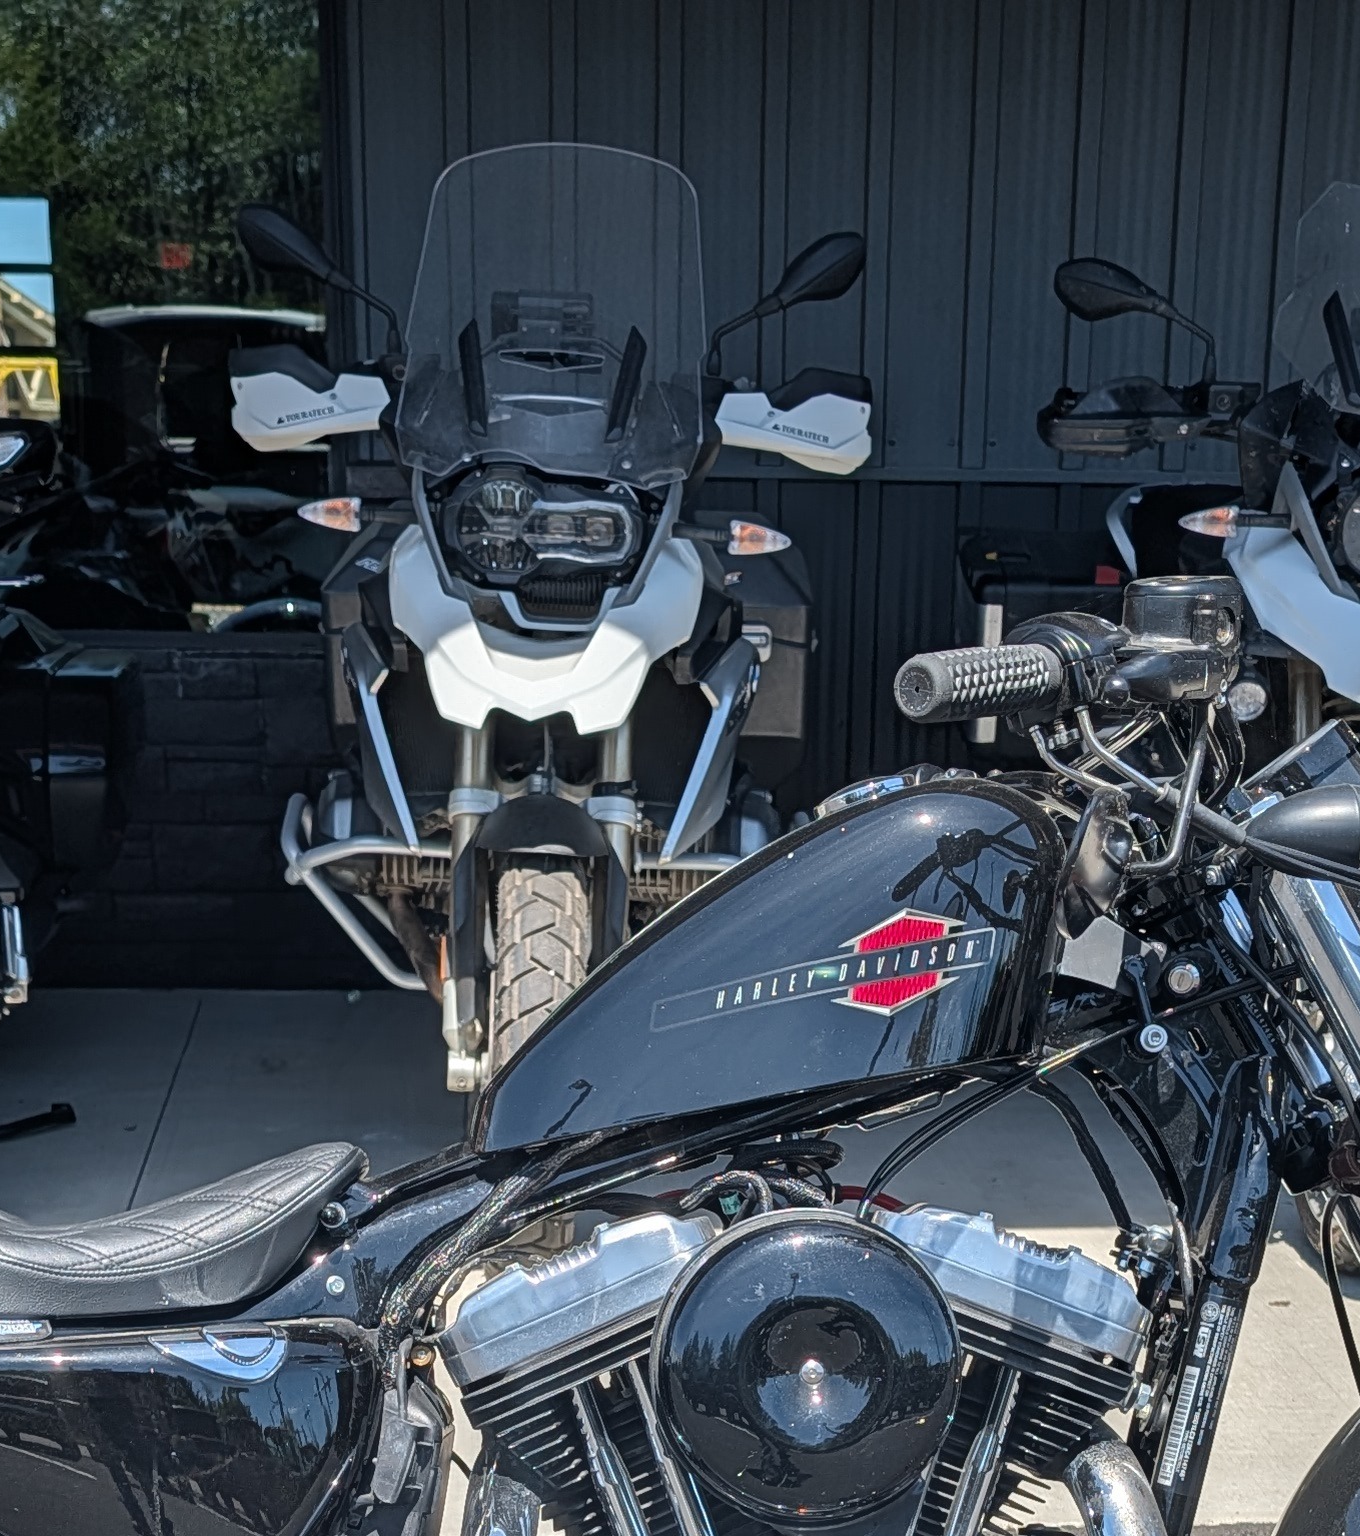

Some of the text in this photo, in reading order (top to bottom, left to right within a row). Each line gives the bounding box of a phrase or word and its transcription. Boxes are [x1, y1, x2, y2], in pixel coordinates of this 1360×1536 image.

[285, 406, 335, 422] TOURATECH
[782, 424, 830, 444] TOURATECH
[715, 941, 977, 1009] HARLEY-DAVIDSON
